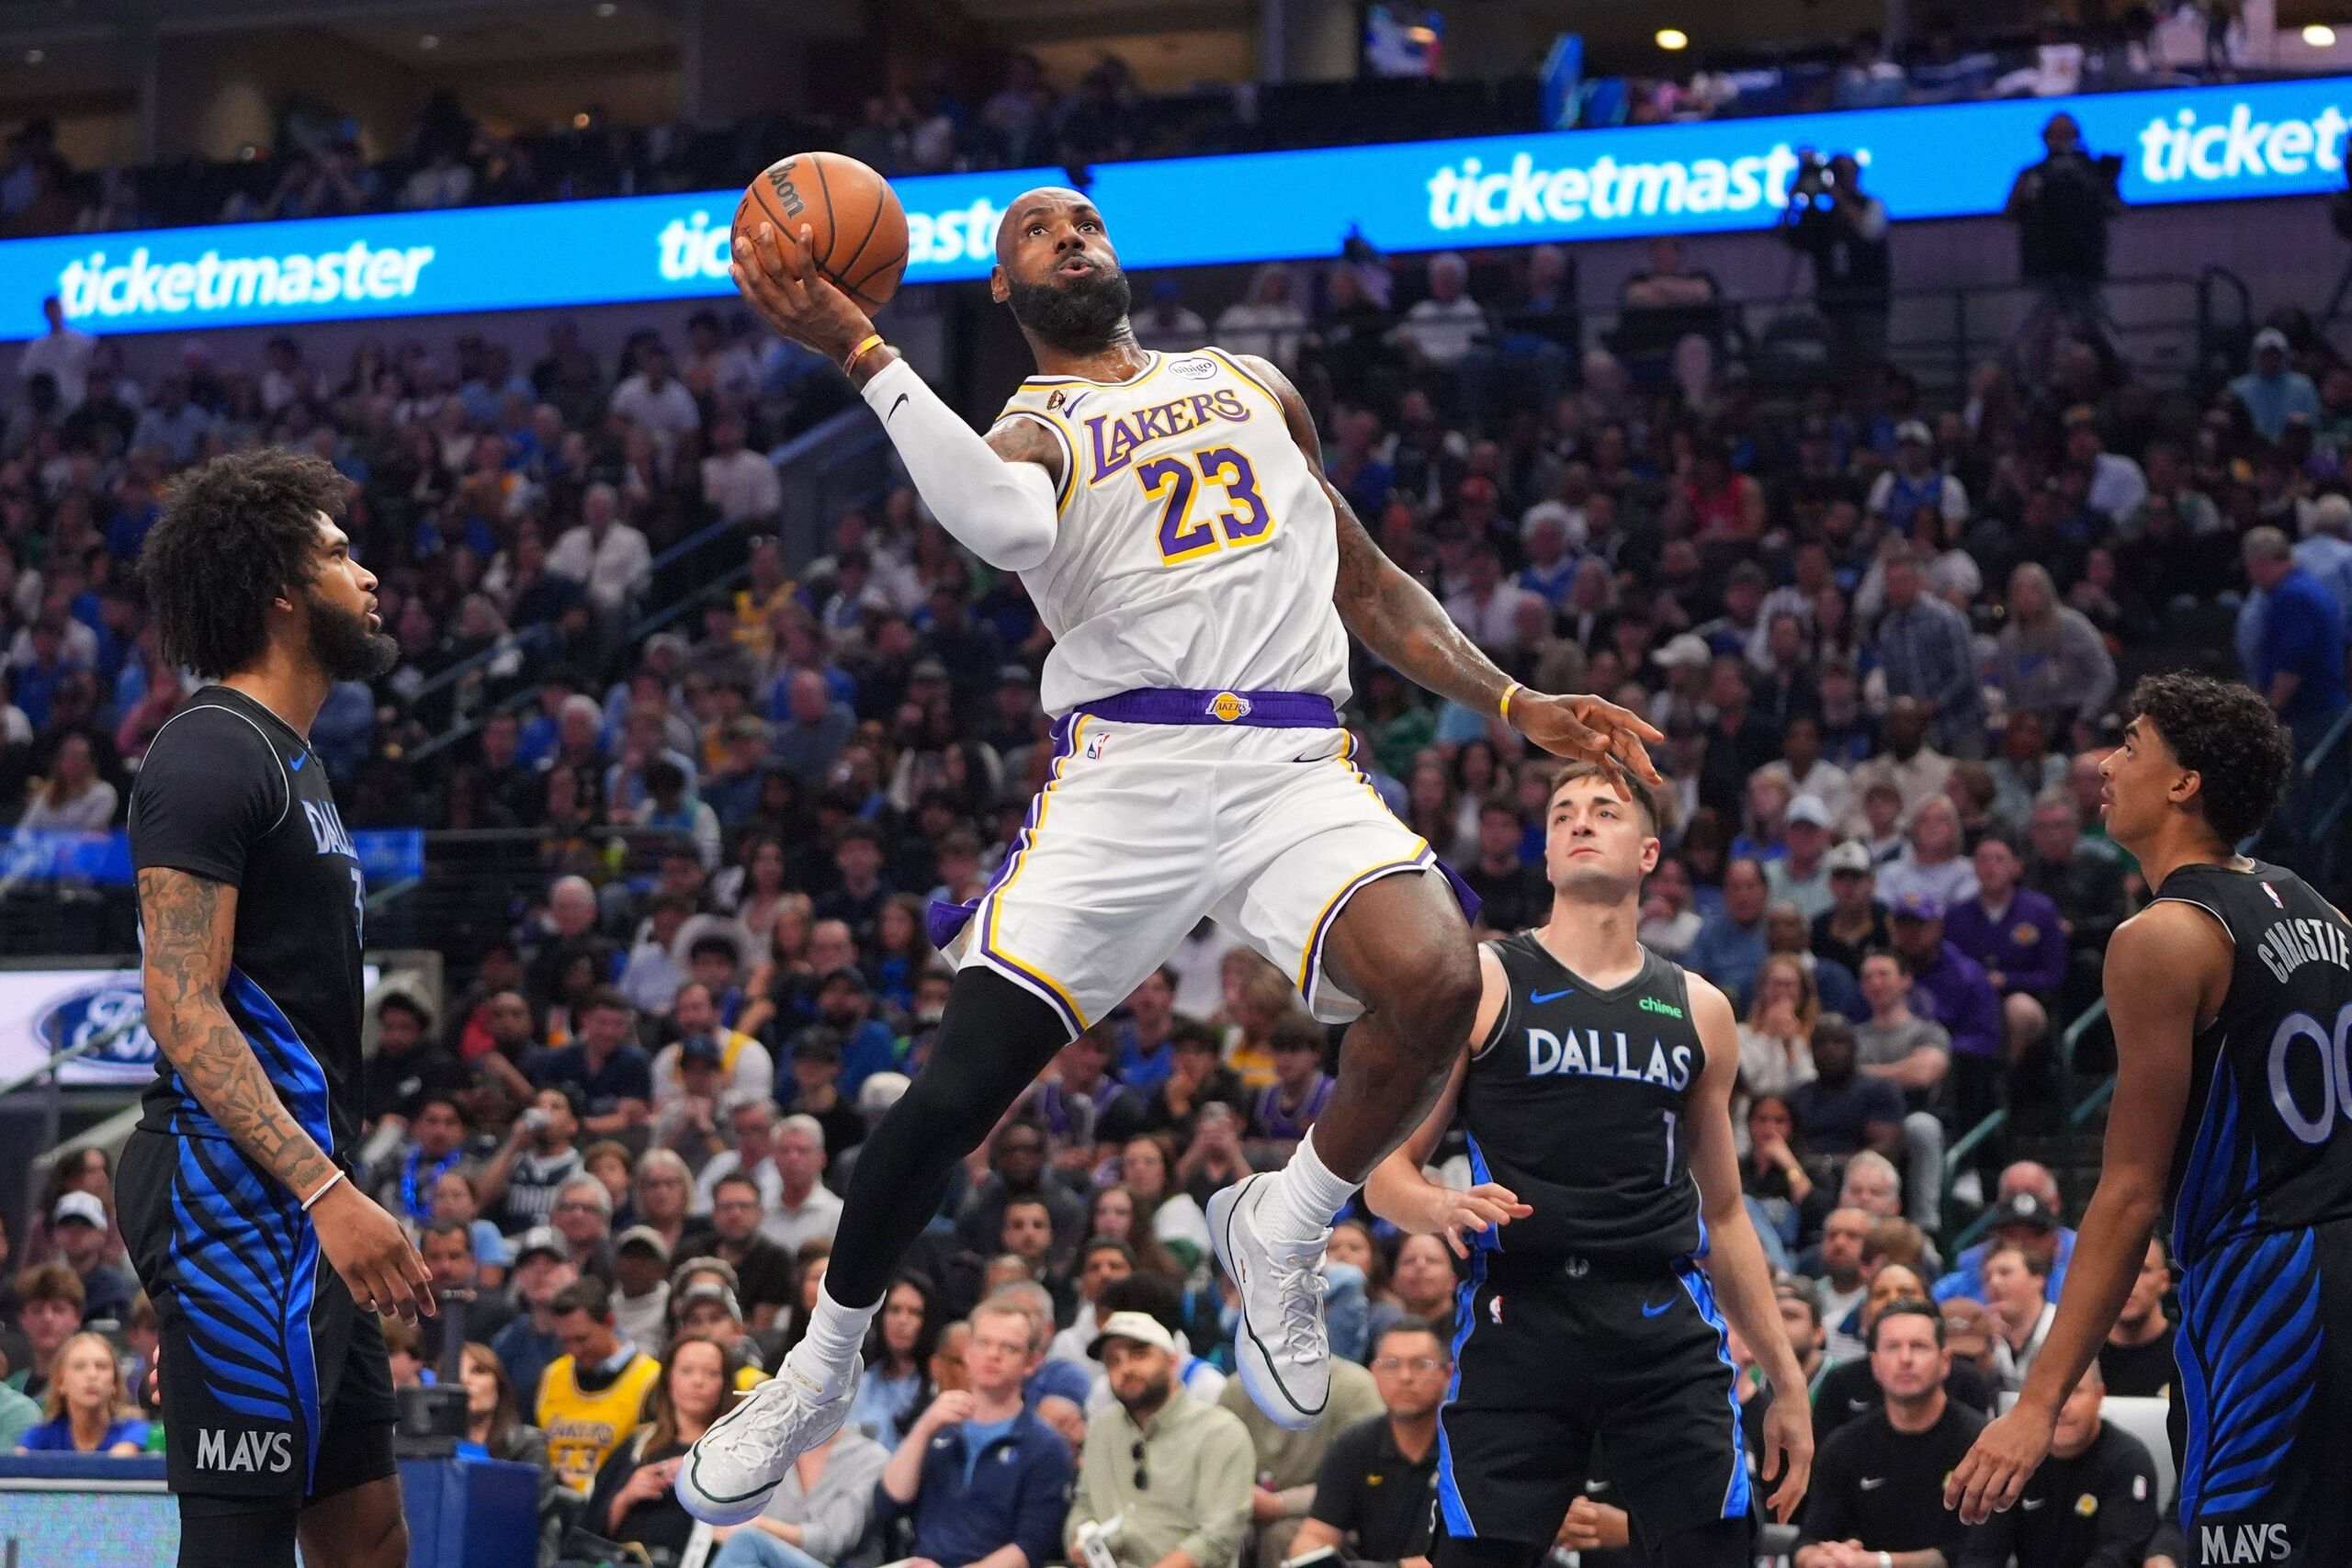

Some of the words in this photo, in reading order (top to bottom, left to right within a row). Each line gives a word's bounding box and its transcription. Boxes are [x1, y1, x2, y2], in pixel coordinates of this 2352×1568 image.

[2139, 102, 2352, 183] ticket
[1426, 142, 1872, 230] ticketmast
[60, 240, 435, 319] ticketmaster
[1172, 363, 1212, 374] bibigo
[1082, 389, 1253, 489] LAKERS
[1134, 443, 1276, 568] 23
[2257, 919, 2350, 984] CHRISTIE
[1638, 997, 1683, 1019] chime
[1525, 1024, 1692, 1092] DALLAS
[1663, 1109, 1676, 1186] 1
[196, 1428, 292, 1472] MAVS
[2200, 1523, 2291, 1565] MAVS
